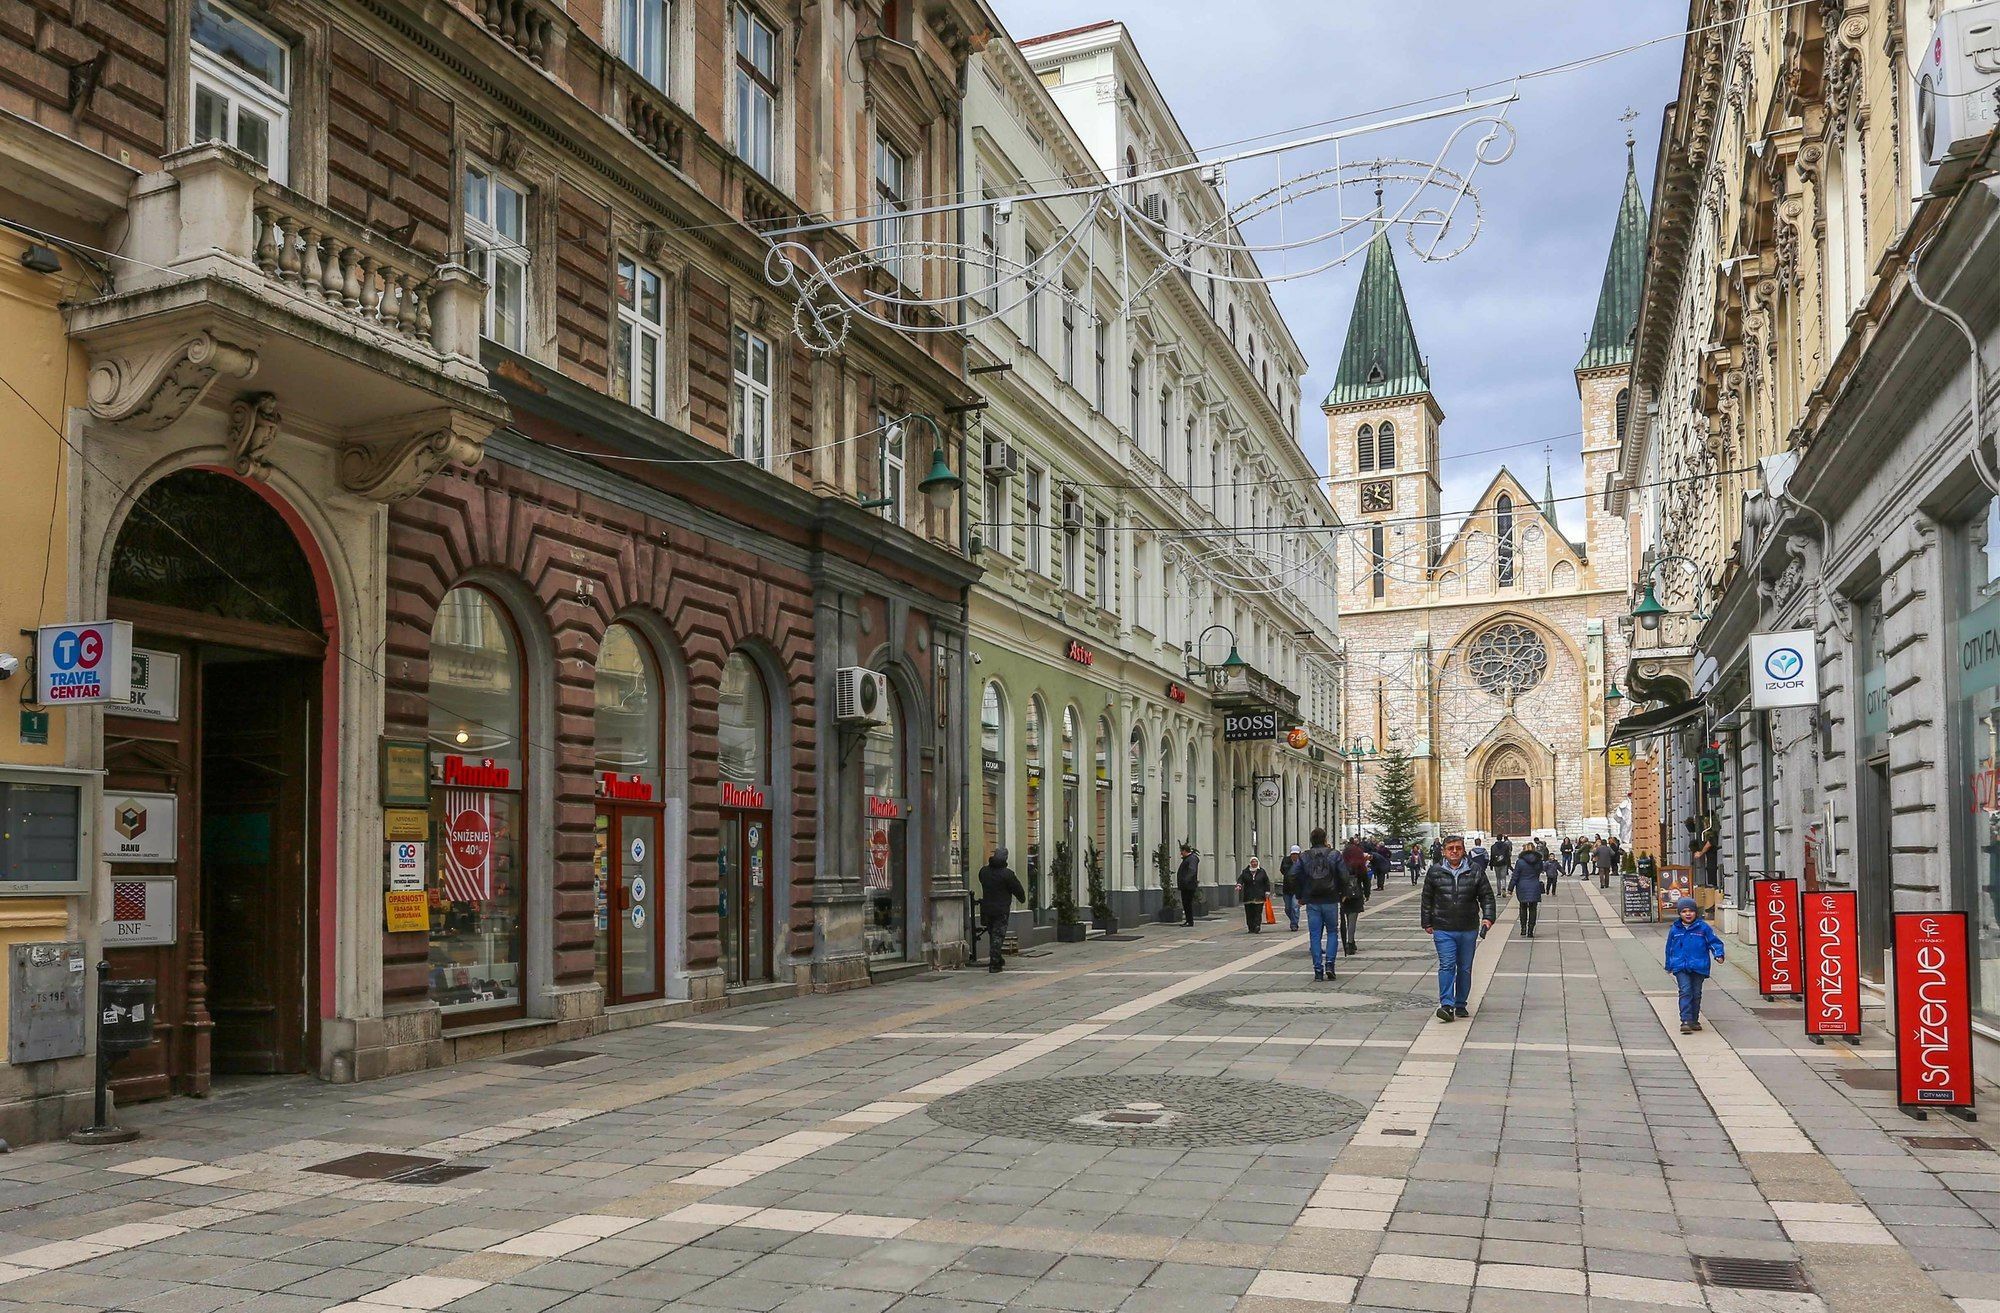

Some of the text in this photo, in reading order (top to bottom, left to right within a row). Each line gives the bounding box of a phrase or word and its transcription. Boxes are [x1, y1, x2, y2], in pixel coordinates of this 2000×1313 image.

[56, 633, 101, 666] TC
[1963, 629, 2000, 671] CITY FA
[50, 671, 100, 686] TRAVEL
[50, 685, 100, 699] CENTAR
[1765, 680, 1805, 690] IZVOR
[130, 691, 147, 705] BK
[1867, 688, 1881, 715] CITY
[1226, 715, 1274, 731] BOSS
[444, 755, 509, 788] Planika
[603, 772, 653, 800] Planika
[721, 781, 764, 808] Planika
[121, 844, 140, 852] BANU
[452, 829, 489, 842] SNIŽENJE
[118, 923, 141, 935] BNF
[1767, 900, 1789, 982] sniženje
[1816, 917, 1843, 1020] sniženje
[1913, 946, 1950, 1086] sniženje
